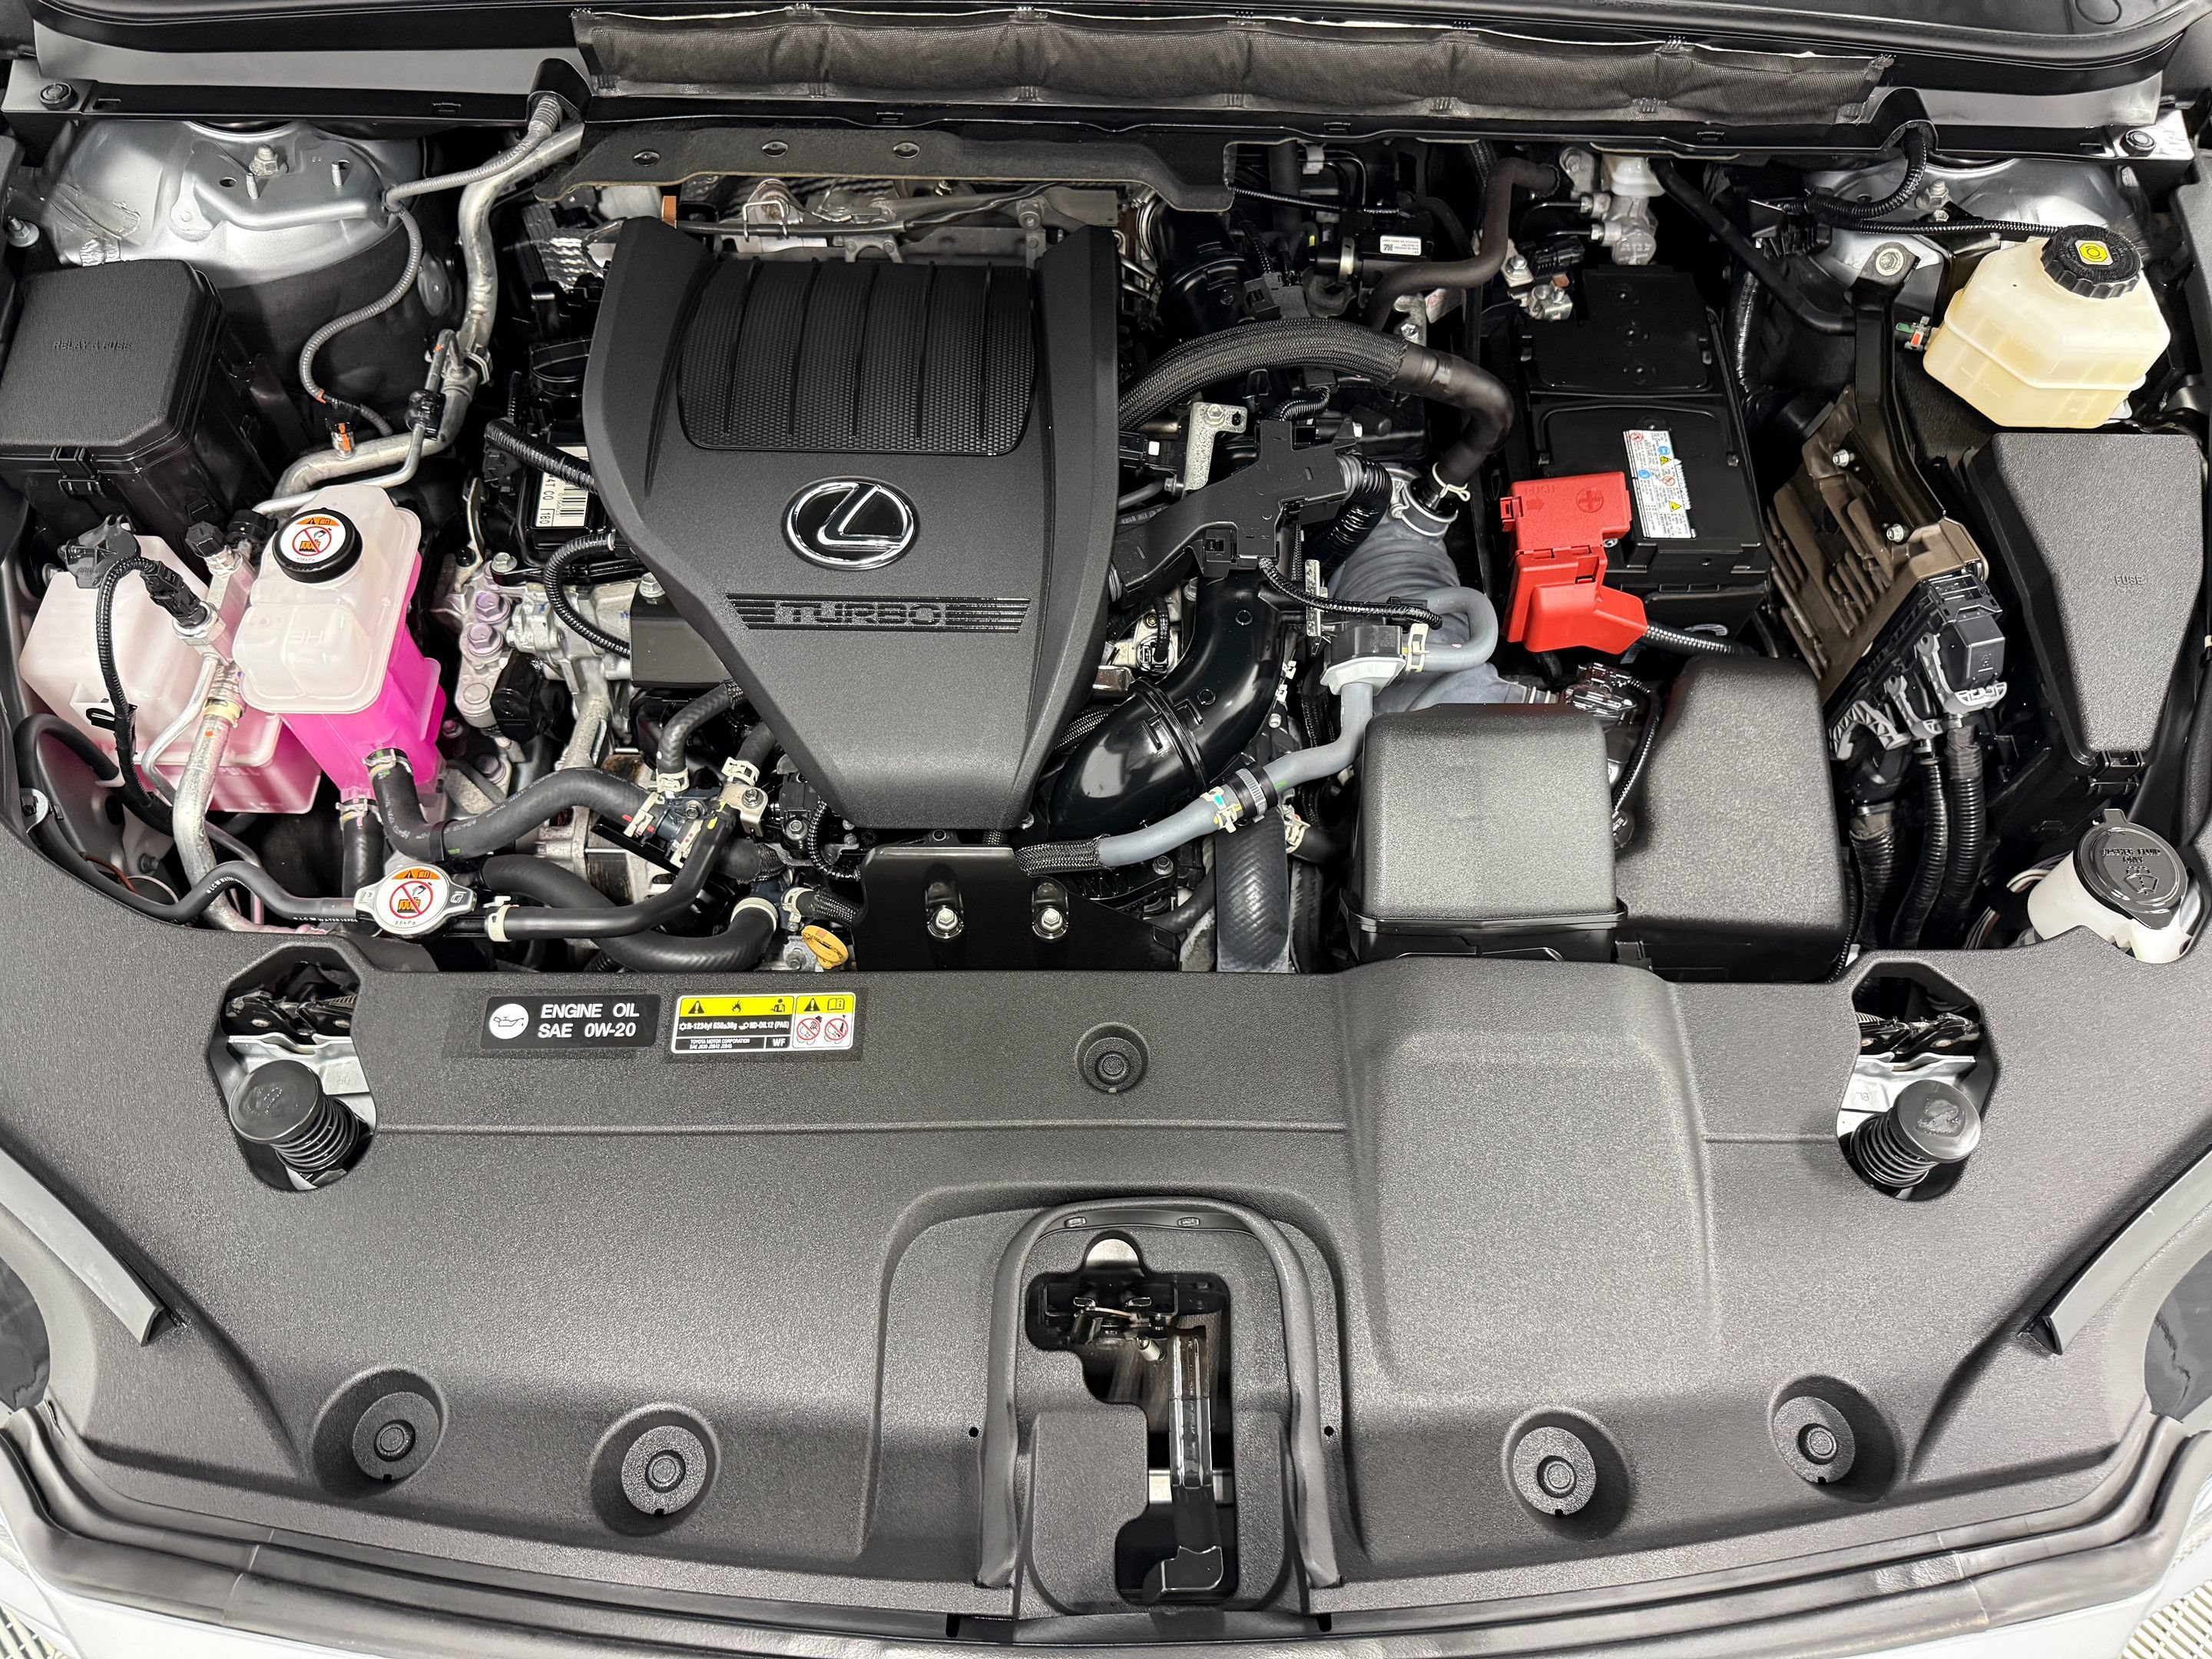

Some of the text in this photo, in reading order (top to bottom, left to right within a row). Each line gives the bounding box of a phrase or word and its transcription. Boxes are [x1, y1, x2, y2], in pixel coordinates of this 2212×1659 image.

[2114, 575, 2144, 584] FUSE
[779, 601, 942, 627] TURBO
[2122, 856, 2144, 864] ONLY
[541, 1002, 640, 1018] ENGINE OIL
[538, 1022, 637, 1038] SAE 0W-20
[772, 1038, 786, 1047] WF
